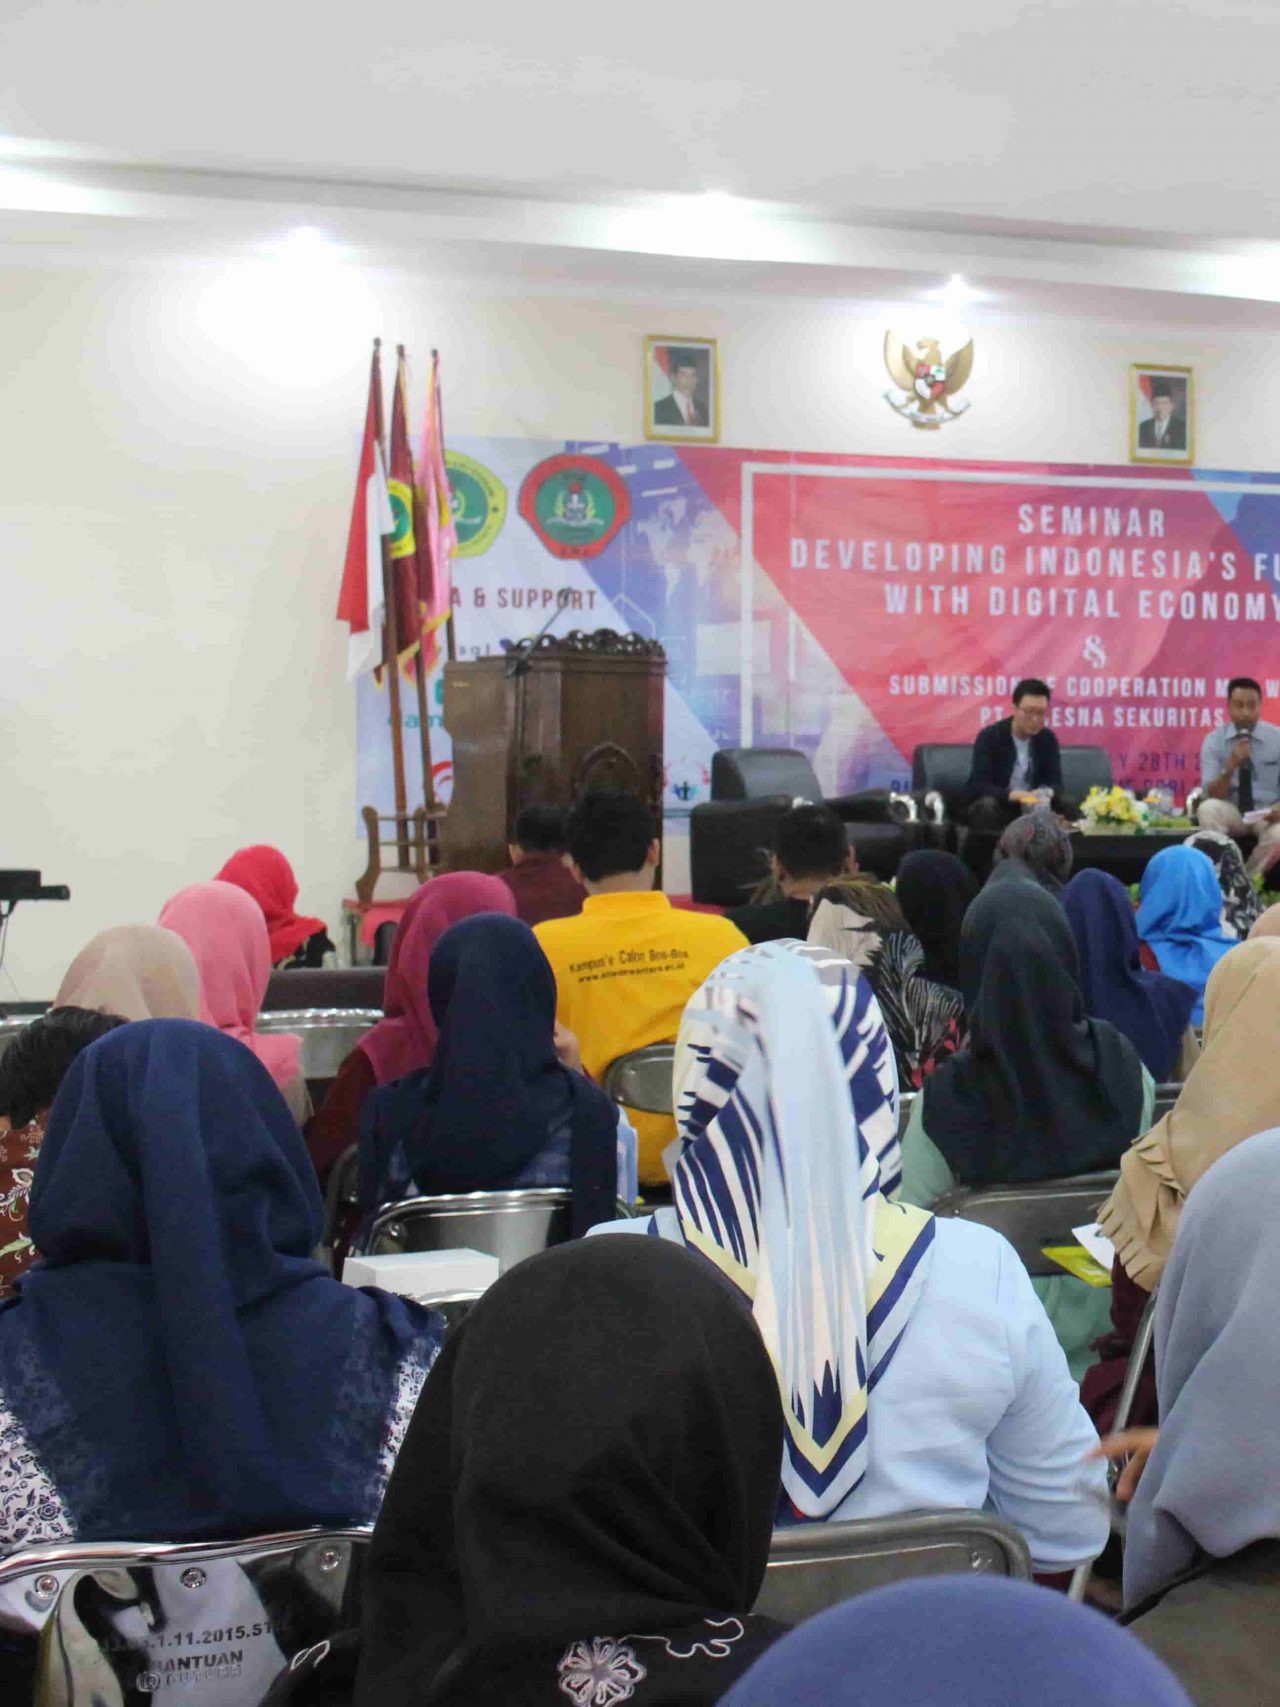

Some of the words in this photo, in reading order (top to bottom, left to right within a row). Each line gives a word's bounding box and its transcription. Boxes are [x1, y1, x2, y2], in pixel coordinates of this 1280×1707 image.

[1017, 504, 1165, 537] SEMINAR
[789, 537, 1007, 575] DEVELOPING
[1026, 546, 1236, 580] INDONESIA'S
[498, 587, 597, 609] SUPPORT
[884, 582, 969, 615] WITH
[988, 586, 1120, 618] DIGITAL
[1066, 676, 1206, 698] COOPERATION
[1113, 707, 1224, 728] SEKURITAS
